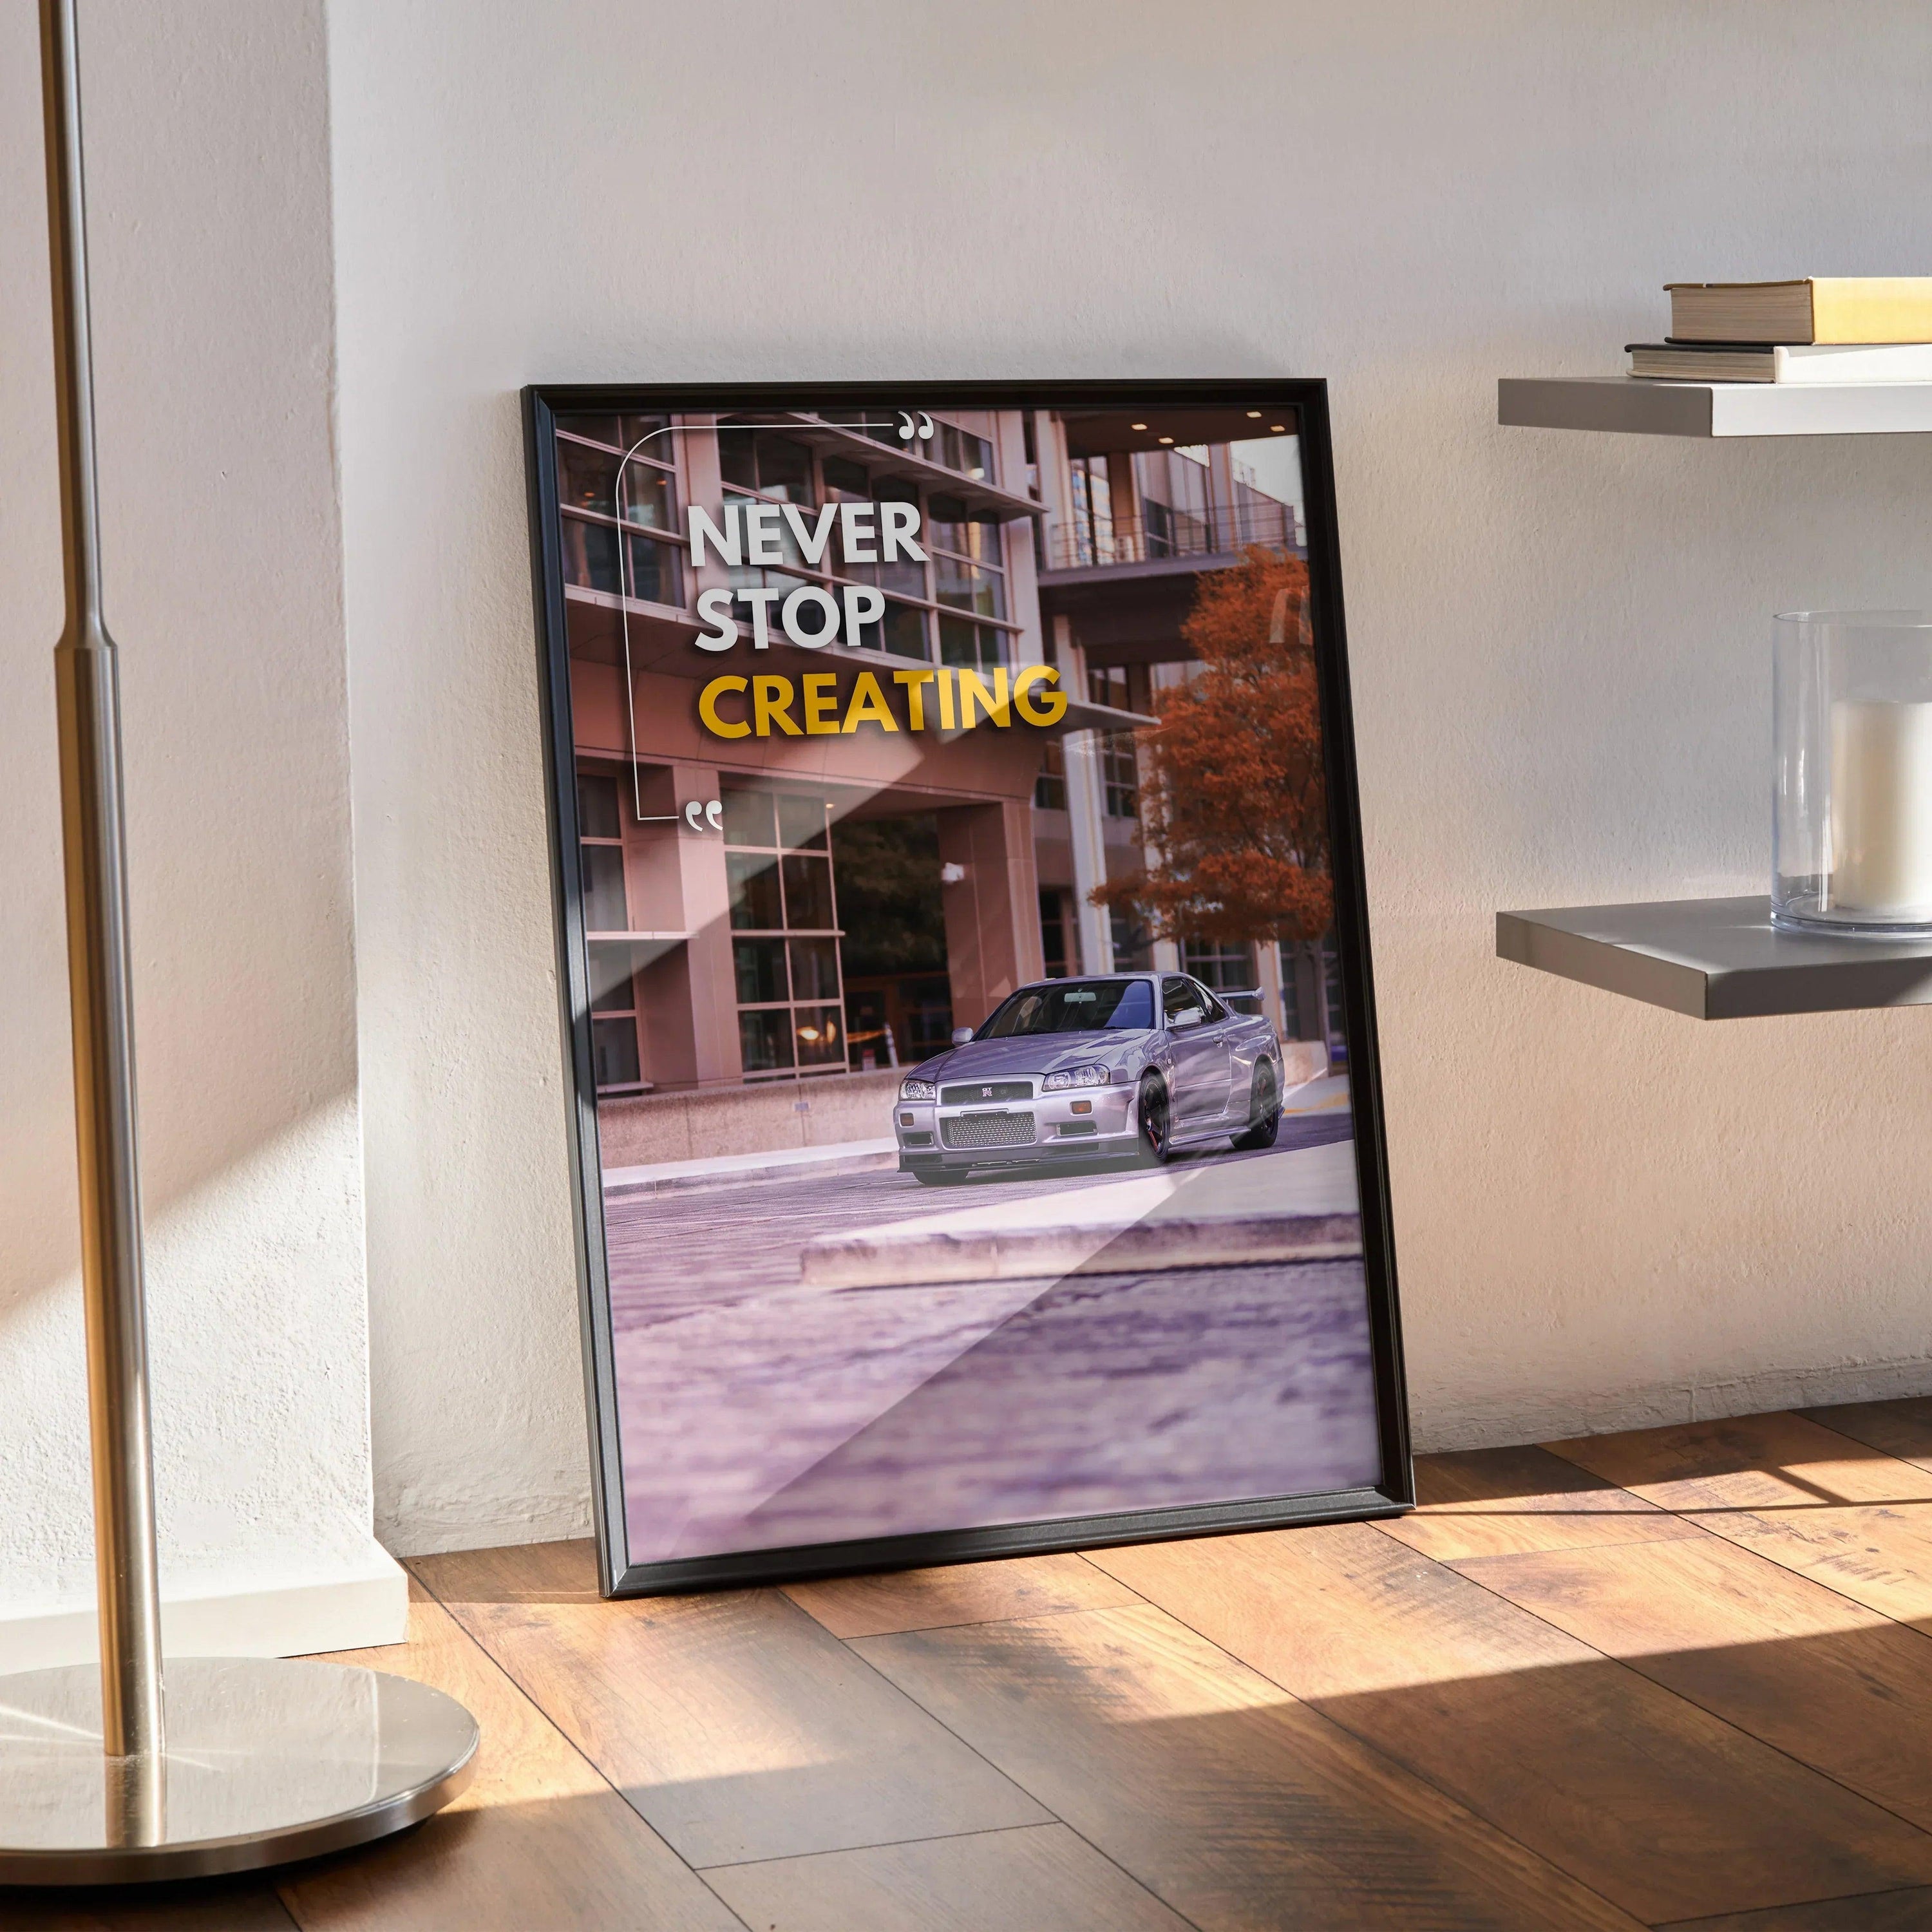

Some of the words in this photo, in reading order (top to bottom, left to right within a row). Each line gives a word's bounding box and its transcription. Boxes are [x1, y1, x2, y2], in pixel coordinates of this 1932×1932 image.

[688, 502, 931, 567] NEVER
[694, 585, 886, 651] STOP
[699, 665, 1068, 739] CREATING
